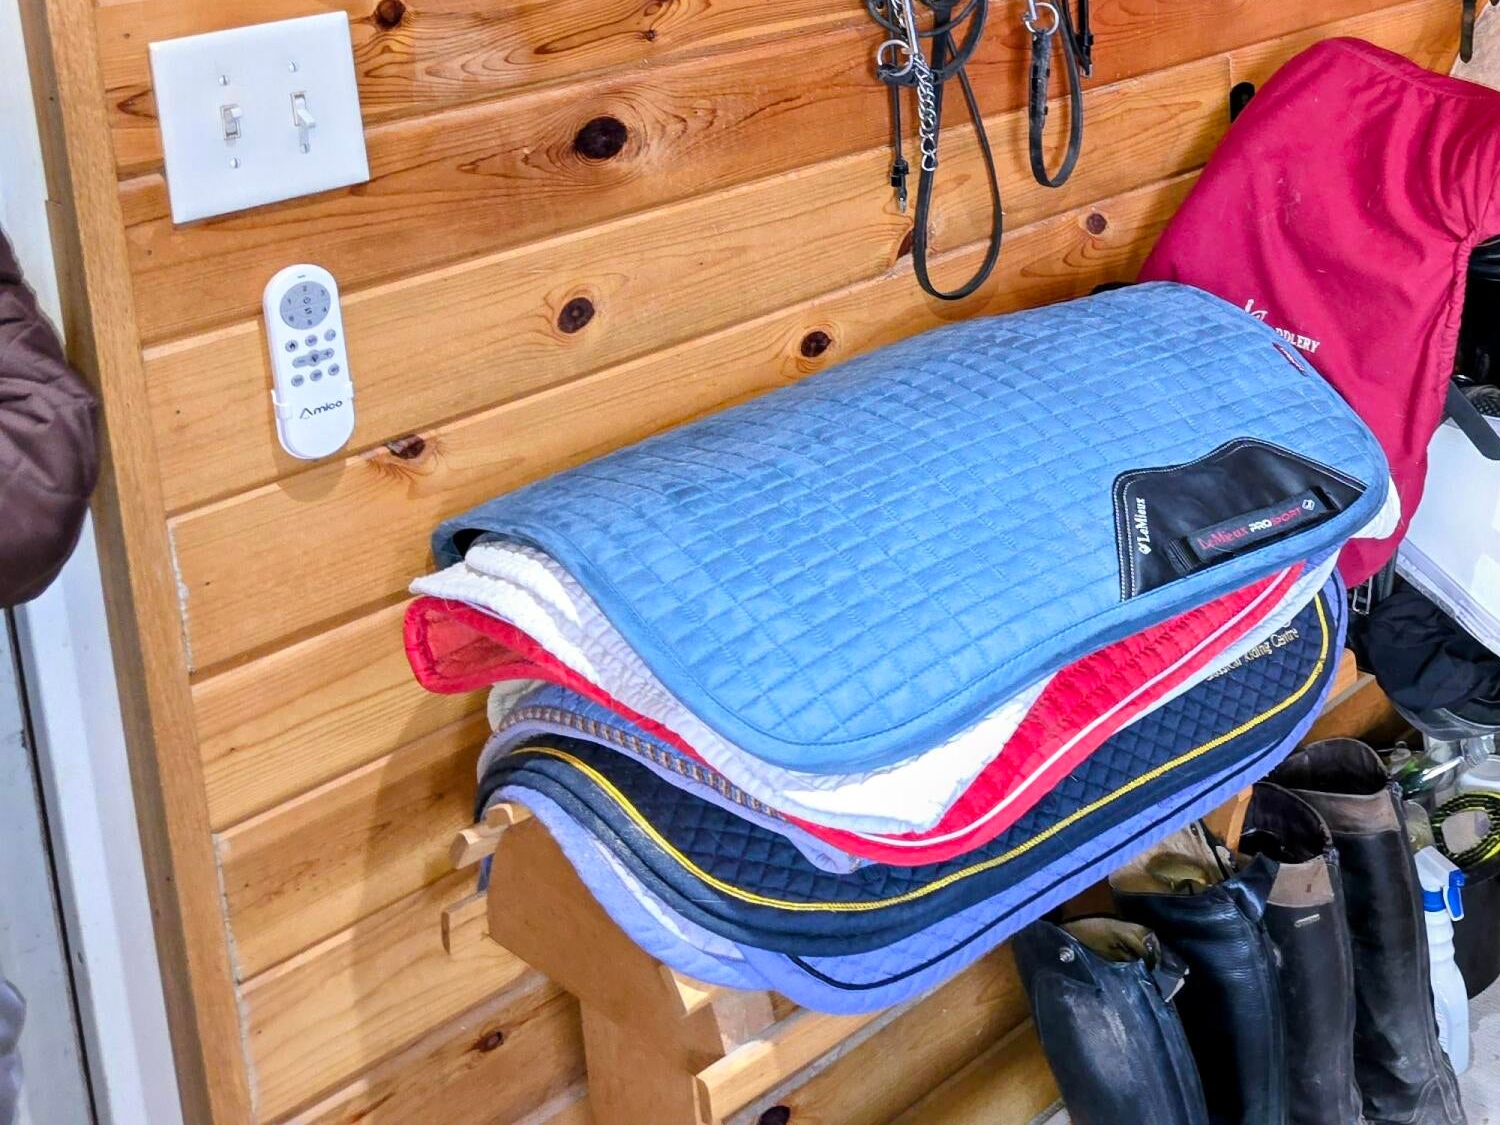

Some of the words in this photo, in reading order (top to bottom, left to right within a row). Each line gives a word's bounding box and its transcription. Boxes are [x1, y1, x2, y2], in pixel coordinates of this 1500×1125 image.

[1134, 497, 1151, 542] LeMieux
[1197, 526, 1249, 551] LeMieux
[1270, 627, 1300, 647] Centre
